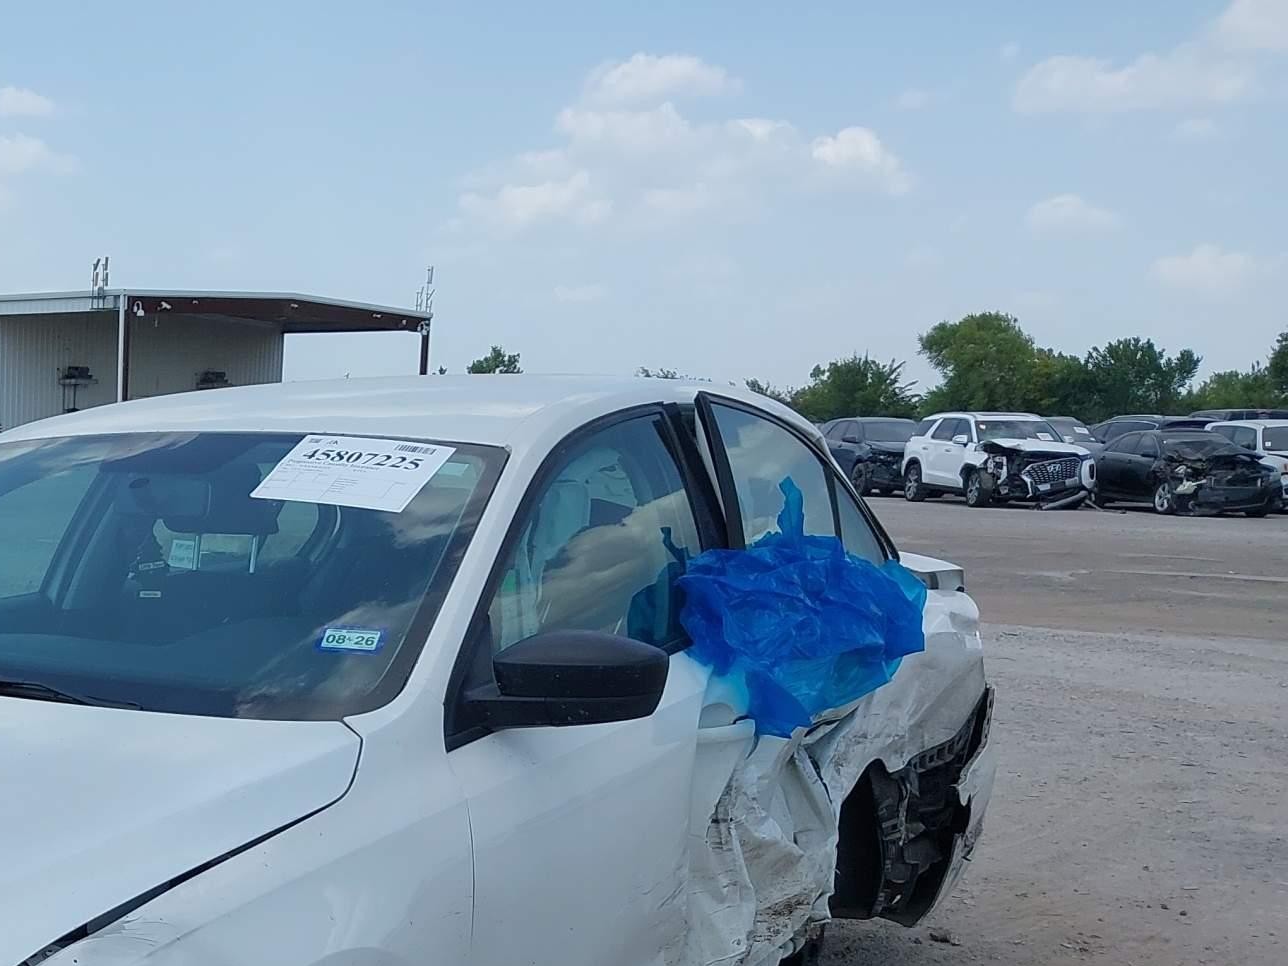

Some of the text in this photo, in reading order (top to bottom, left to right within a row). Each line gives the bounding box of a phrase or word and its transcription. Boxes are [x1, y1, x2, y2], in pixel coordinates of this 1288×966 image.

[302, 448, 425, 470] 45807225
[325, 634, 376, 646] 08 26
